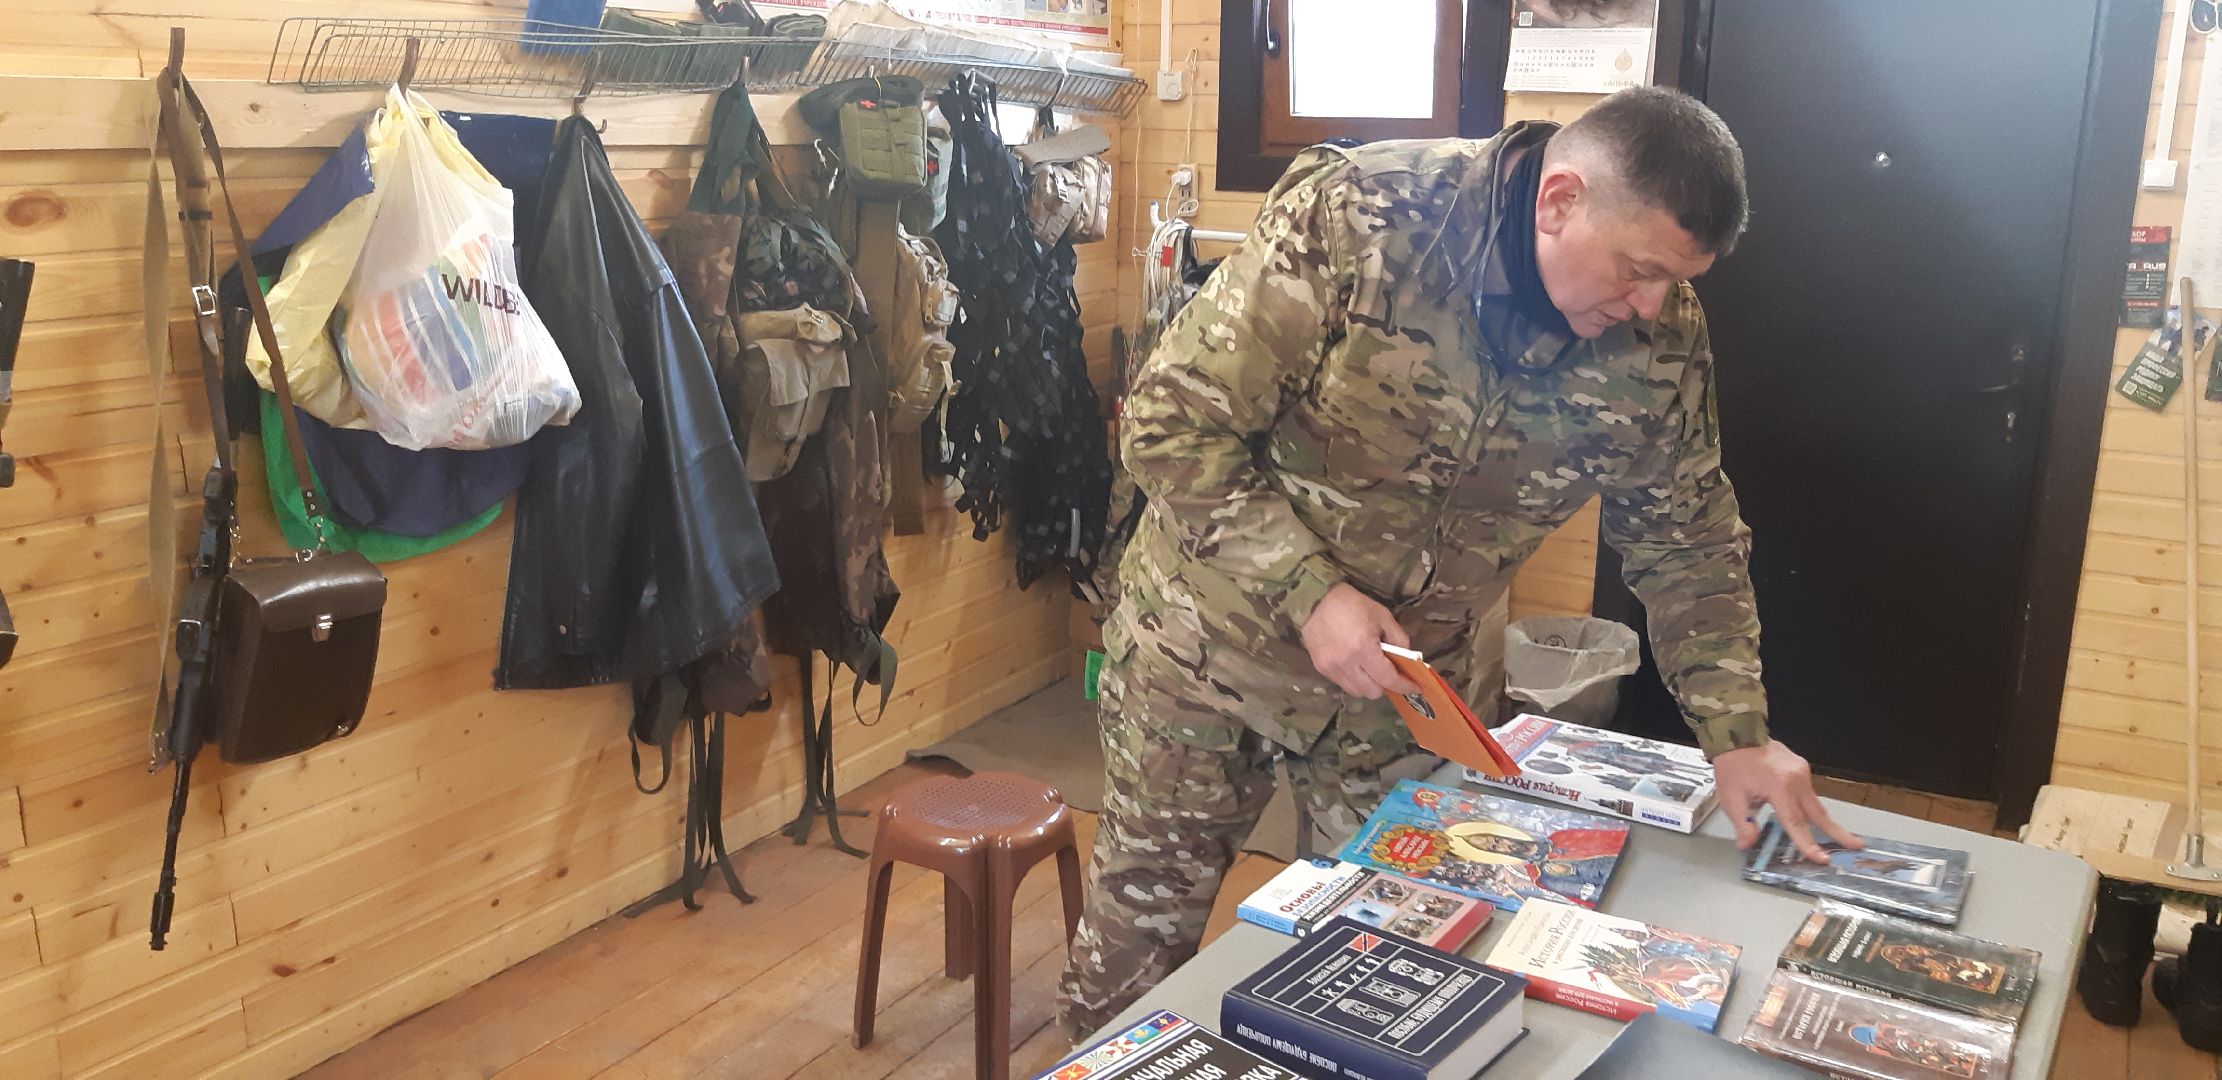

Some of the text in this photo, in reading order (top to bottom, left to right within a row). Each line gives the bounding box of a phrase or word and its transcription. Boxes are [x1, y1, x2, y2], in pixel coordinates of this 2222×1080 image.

[1236, 1023, 1273, 1048] ОПОЛЧЕНЦУ
[1272, 1036, 1308, 1063] БУДУЩЕМУ
[1308, 1053, 1338, 1073] ПОСОБИЕ
